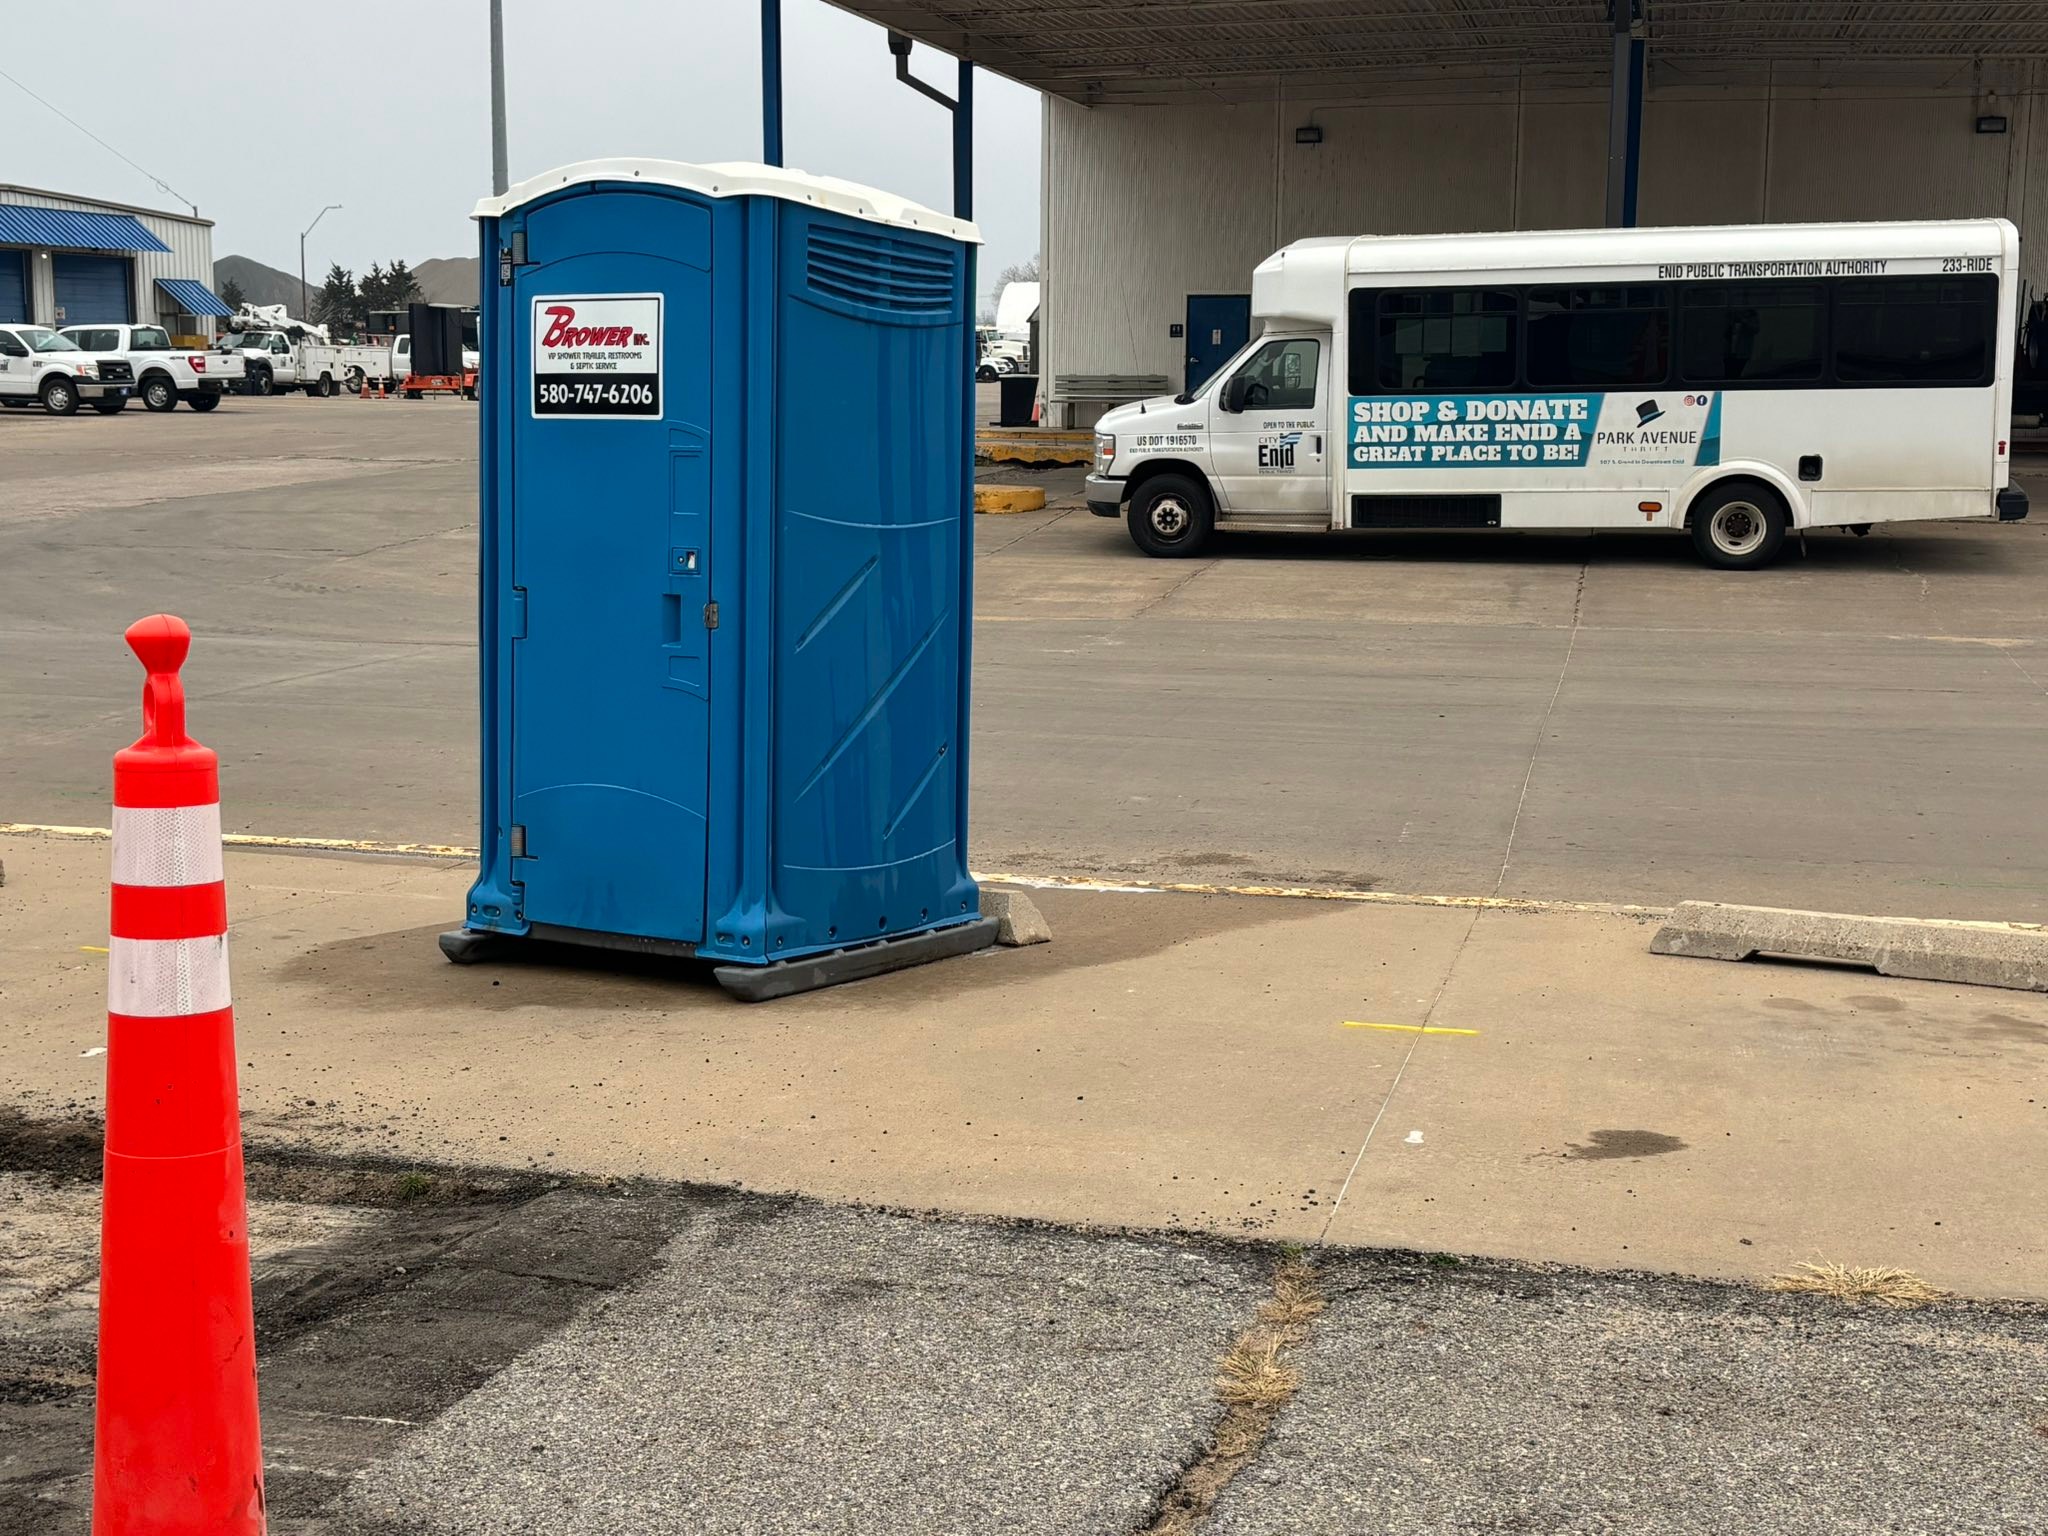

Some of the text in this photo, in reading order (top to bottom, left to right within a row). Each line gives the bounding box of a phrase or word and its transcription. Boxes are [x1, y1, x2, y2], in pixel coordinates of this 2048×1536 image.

[1658, 260, 1887, 279] ENID PUBLIC TRANSPORTATION AUTHORITY
[1942, 257, 1993, 272] 233-RIDE
[541, 305, 634, 349] BROWER
[547, 352, 557, 360] VIP
[557, 352, 581, 360] SHOWER
[608, 351, 642, 360] RESTROOMS
[595, 362, 618, 370] SERVICE
[539, 384, 653, 404] 580-747-6206
[1353, 399, 1588, 423] SHOP & DONATE
[1263, 420, 1315, 429] OPEN TO THE PUBLIC
[1354, 422, 1582, 443] AND MAKE ENID A
[1136, 434, 1197, 446] US DOT 1916570
[1597, 431, 1697, 445] PARK AVENUE
[1258, 442, 1295, 469] Enid
[1353, 444, 1580, 463] GREAT PLACE TO BE!
